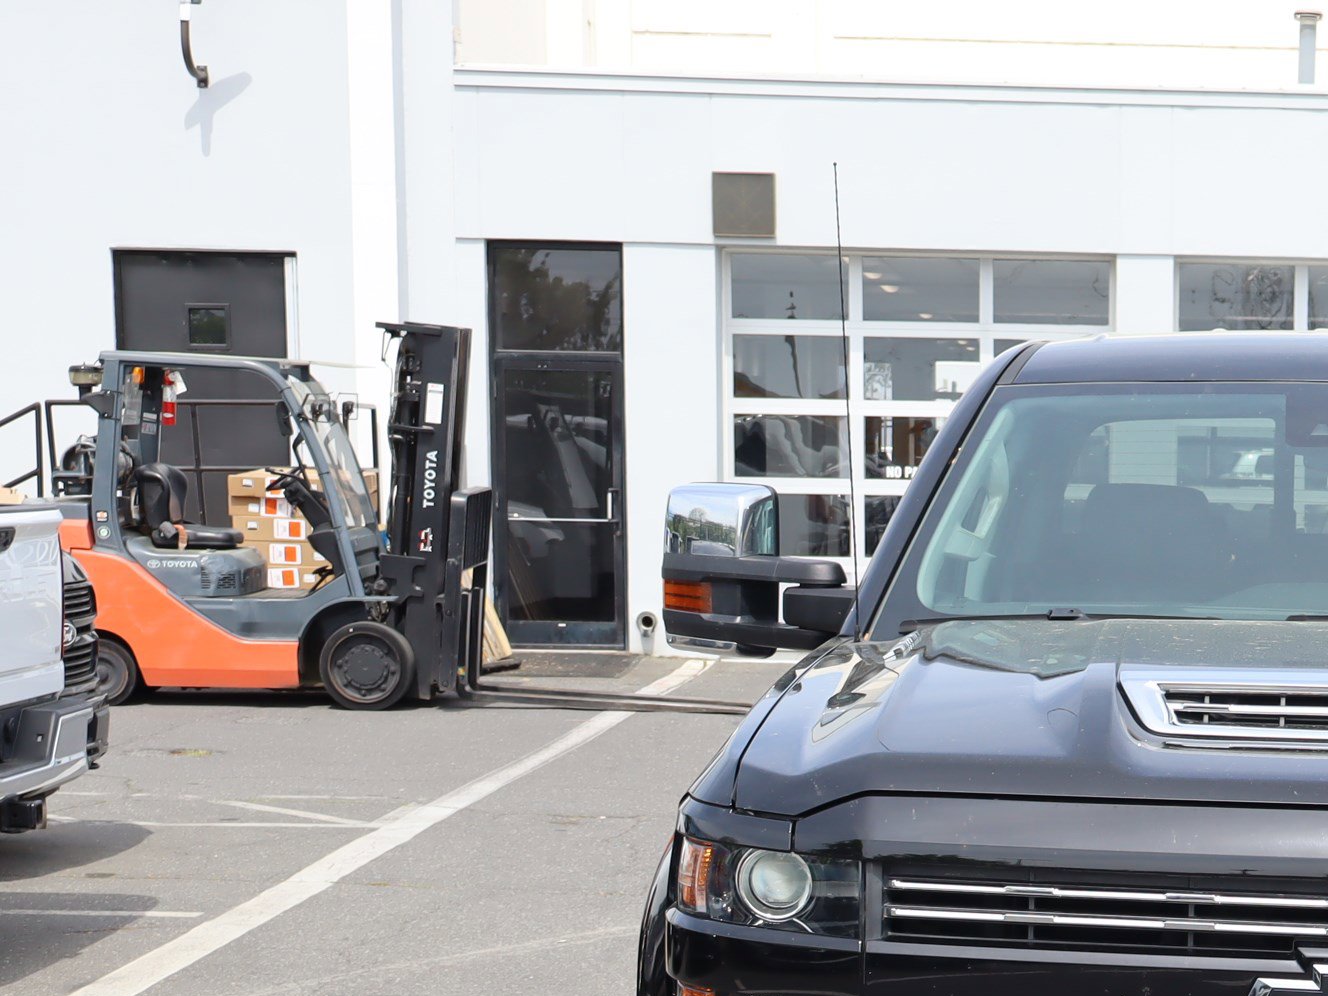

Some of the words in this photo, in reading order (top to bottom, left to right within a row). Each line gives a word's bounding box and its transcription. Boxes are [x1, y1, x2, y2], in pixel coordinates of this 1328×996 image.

[885, 465, 902, 478] NO
[422, 450, 438, 508] TOYOTA
[161, 560, 198, 568] TOYOTA
